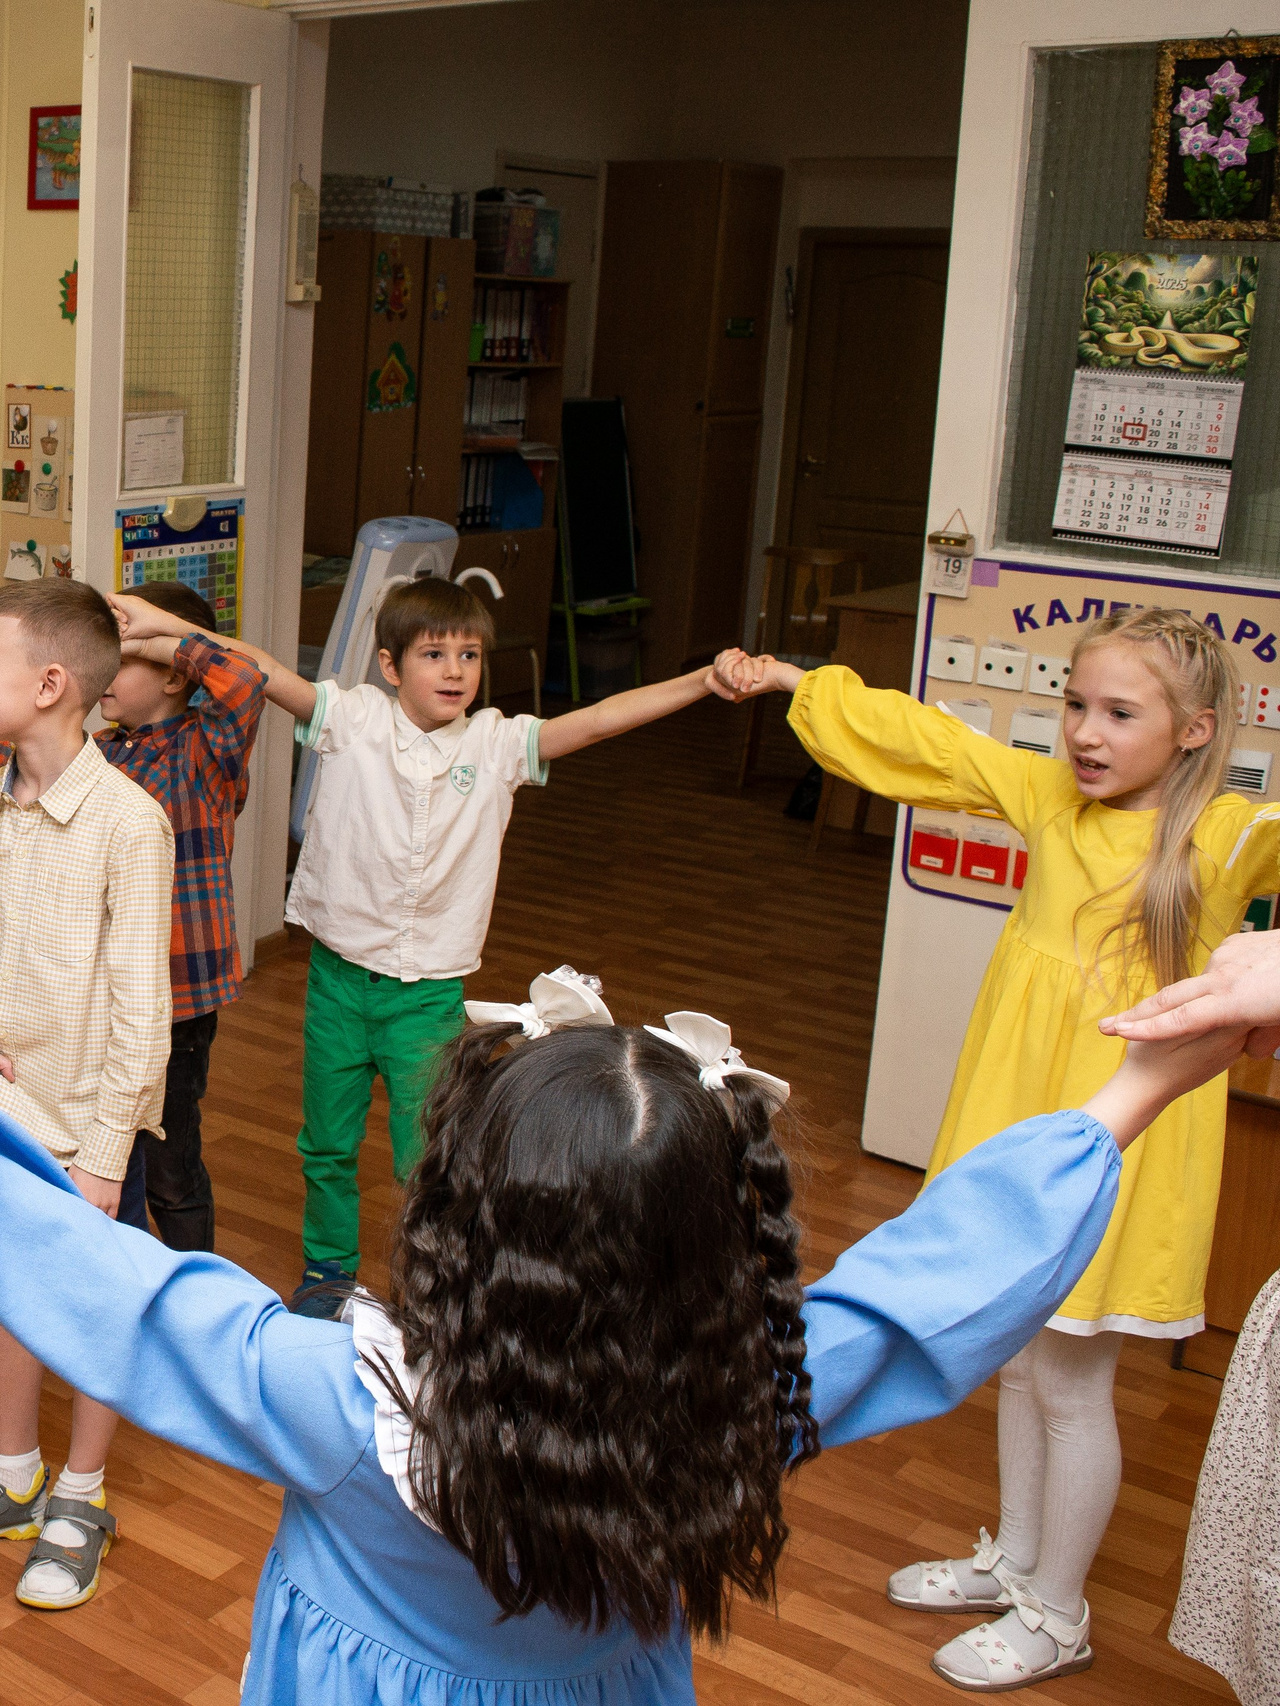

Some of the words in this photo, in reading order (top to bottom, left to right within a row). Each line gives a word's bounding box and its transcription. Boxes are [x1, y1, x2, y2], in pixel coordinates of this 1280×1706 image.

[1196, 386, 1235, 394] November
[10, 430, 30, 446] Кк
[1206, 446, 1217, 454] 30
[1183, 475, 1222, 483] December
[124, 514, 159, 528] УЧИМСЯ
[1197, 513, 1208, 521] 21
[1194, 524, 1206, 532] 28
[125, 529, 159, 541] ЧИТАТЬ
[944, 558, 962, 574] 19
[1012, 597, 1278, 664] КАЛАРЬ
